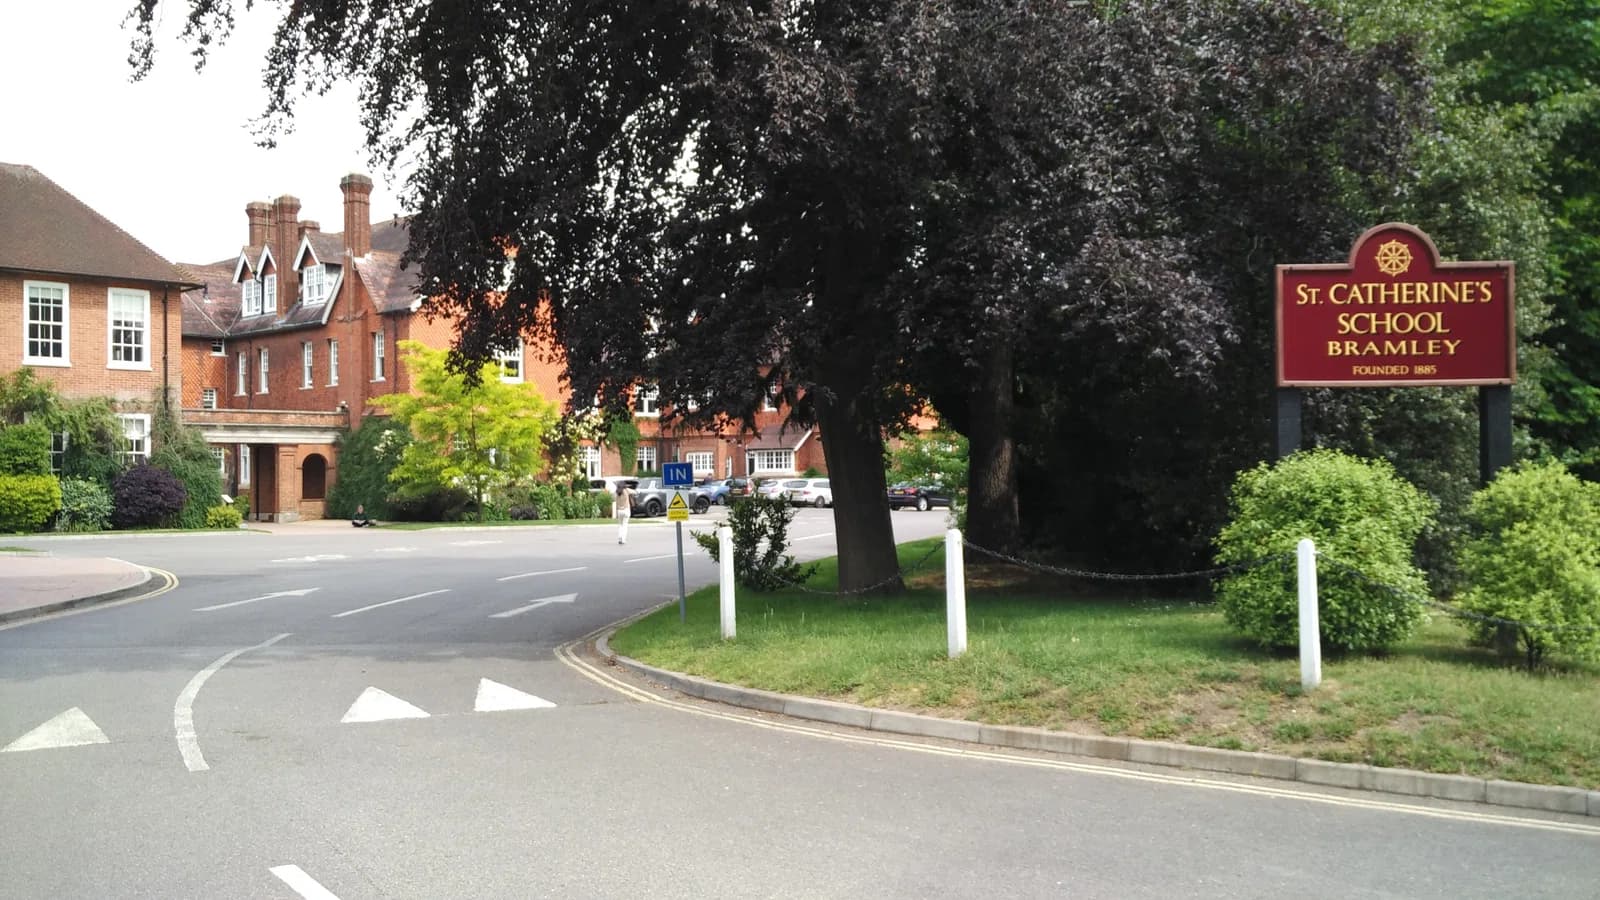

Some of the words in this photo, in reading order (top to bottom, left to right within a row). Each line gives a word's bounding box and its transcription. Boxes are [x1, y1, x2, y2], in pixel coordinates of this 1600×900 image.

[1328, 281, 1492, 304] CATHERINE'S
[1337, 311, 1450, 334] SCHOOL
[1327, 339, 1461, 356] BRAMLEY
[1352, 365, 1409, 375] FOUNDED
[1413, 365, 1437, 375] 1885
[670, 468, 687, 480] IN
